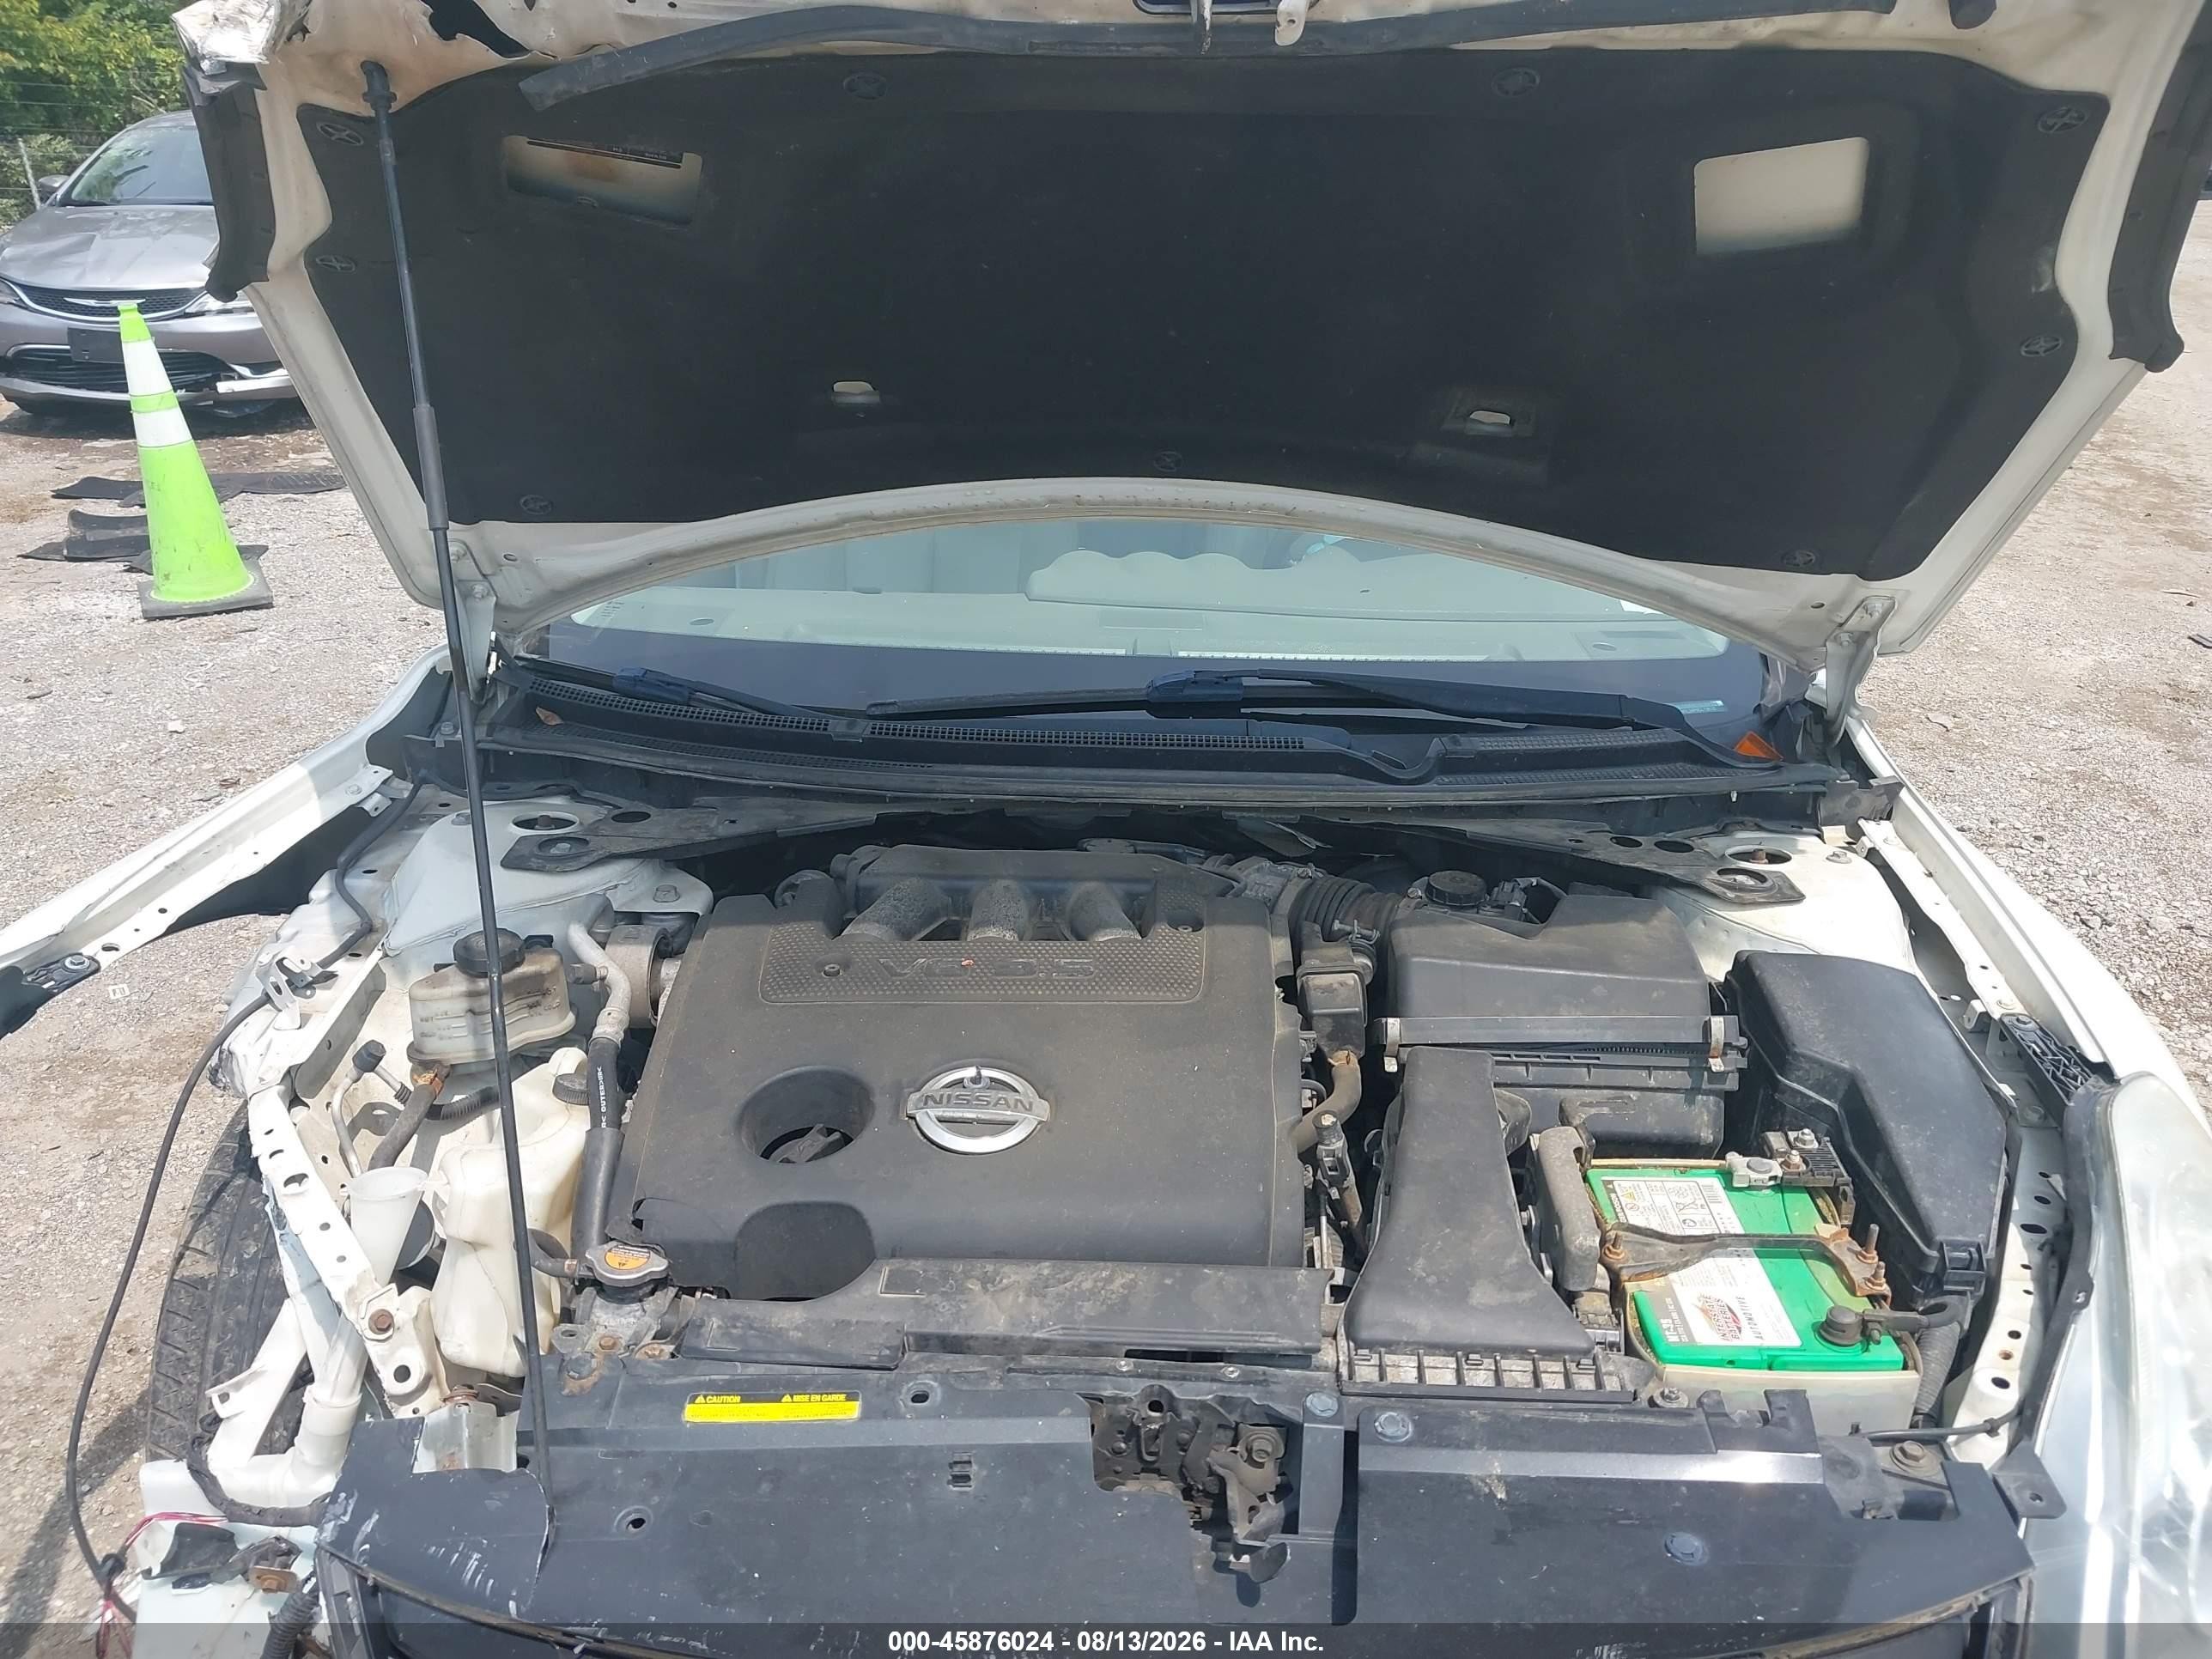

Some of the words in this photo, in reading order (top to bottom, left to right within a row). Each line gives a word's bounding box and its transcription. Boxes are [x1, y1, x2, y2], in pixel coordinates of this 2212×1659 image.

[922, 1091, 1033, 1112] NISSAN
[1699, 1293, 1732, 1341] INTERSTATE
[1715, 1297, 1741, 1340] BATTERIES
[1735, 1295, 1765, 1340] AUTOMOTIVE
[822, 1394, 847, 1402] GARDE
